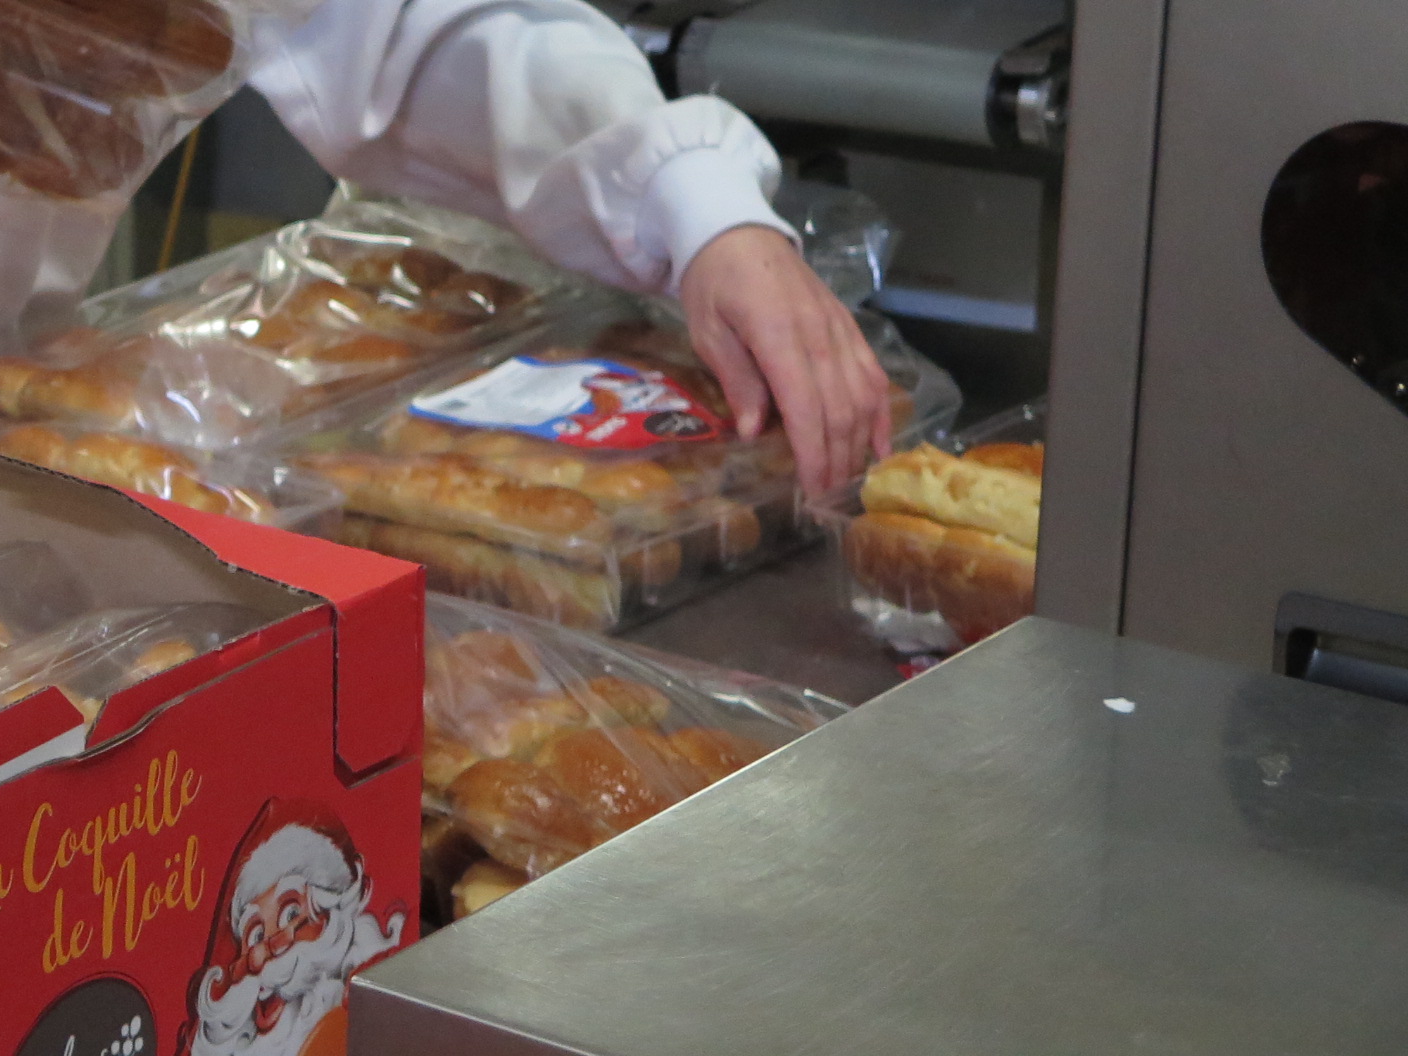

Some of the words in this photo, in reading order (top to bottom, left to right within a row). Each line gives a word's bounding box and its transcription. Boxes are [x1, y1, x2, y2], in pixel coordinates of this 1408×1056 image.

[22, 749, 203, 896] Coquille
[42, 888, 94, 974] de
[102, 834, 205, 960] Noël
